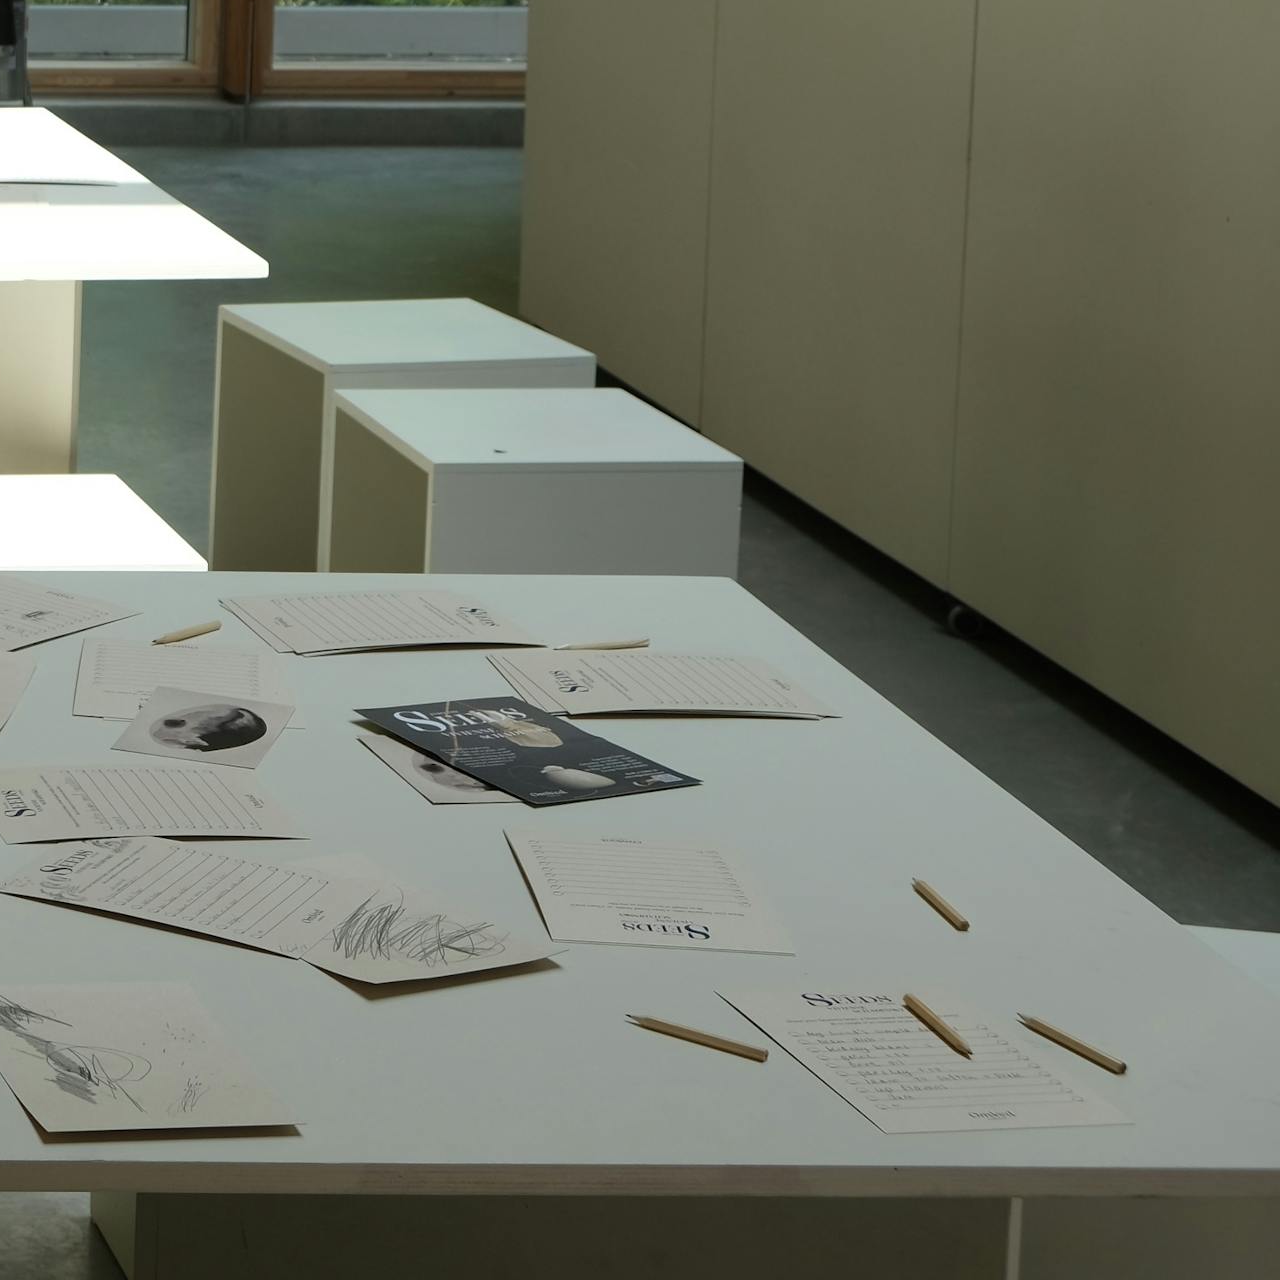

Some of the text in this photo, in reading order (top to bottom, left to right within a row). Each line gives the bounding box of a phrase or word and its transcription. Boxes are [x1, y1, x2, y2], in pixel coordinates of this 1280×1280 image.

[394, 707, 527, 733] SEEDS
[1, 790, 37, 818] SEEDS
[40, 849, 93, 876] SEEDS
[622, 923, 710, 940] SEEDS
[801, 992, 893, 1007] SEEDS
